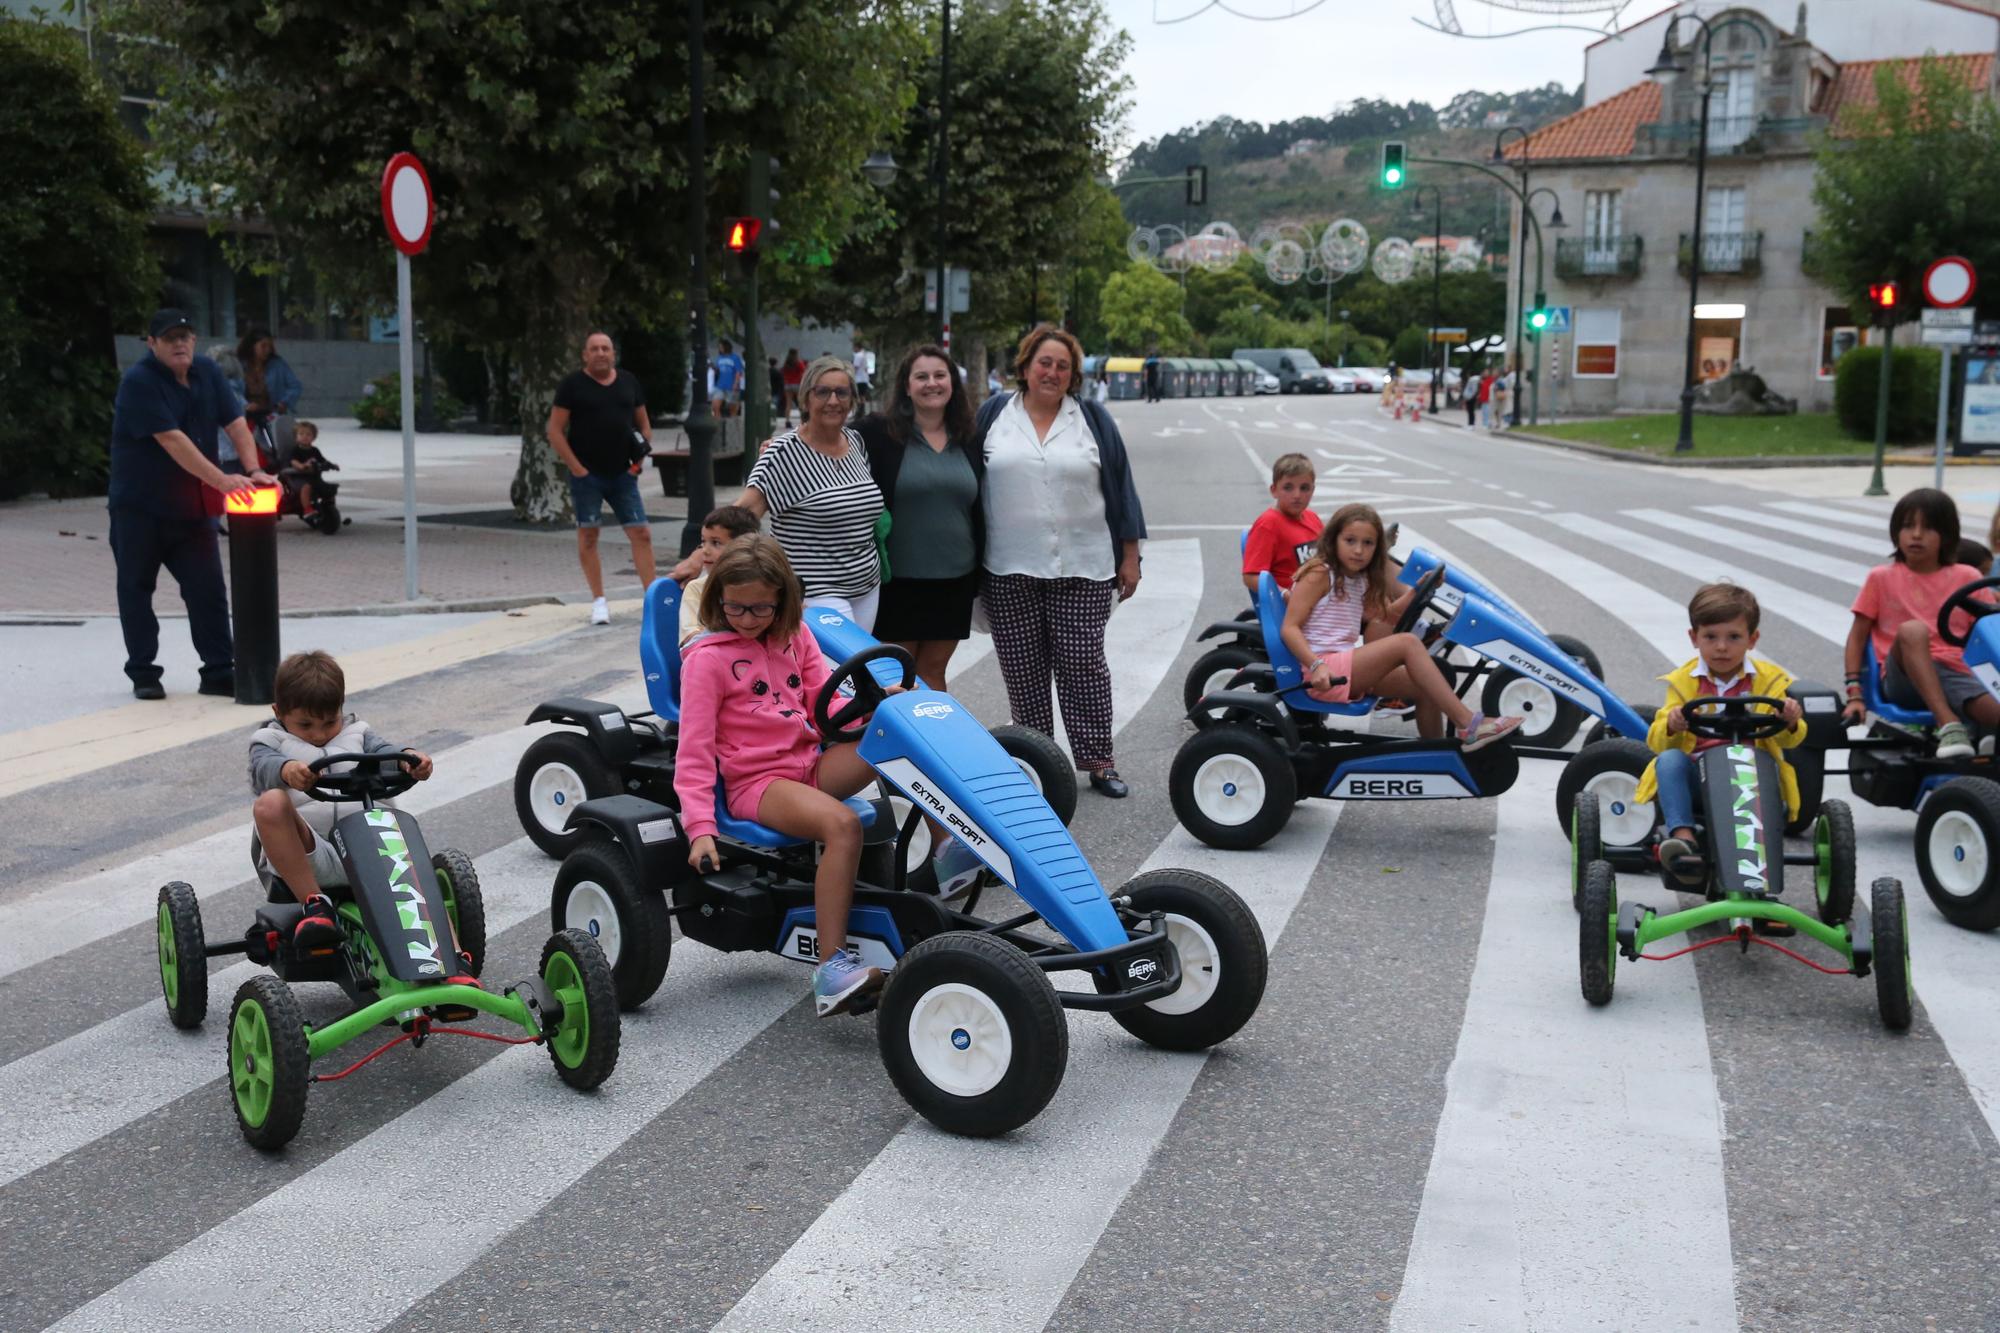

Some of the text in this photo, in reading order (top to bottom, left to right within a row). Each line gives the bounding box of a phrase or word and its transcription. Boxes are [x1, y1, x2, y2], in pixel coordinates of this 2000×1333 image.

[1509, 654, 1580, 693] EXTRA SPORT
[912, 704, 954, 718] BERG
[1350, 780, 1423, 795] BERG
[911, 781, 986, 846] EXTRA SPORT
[1128, 961, 1157, 978] BERG
